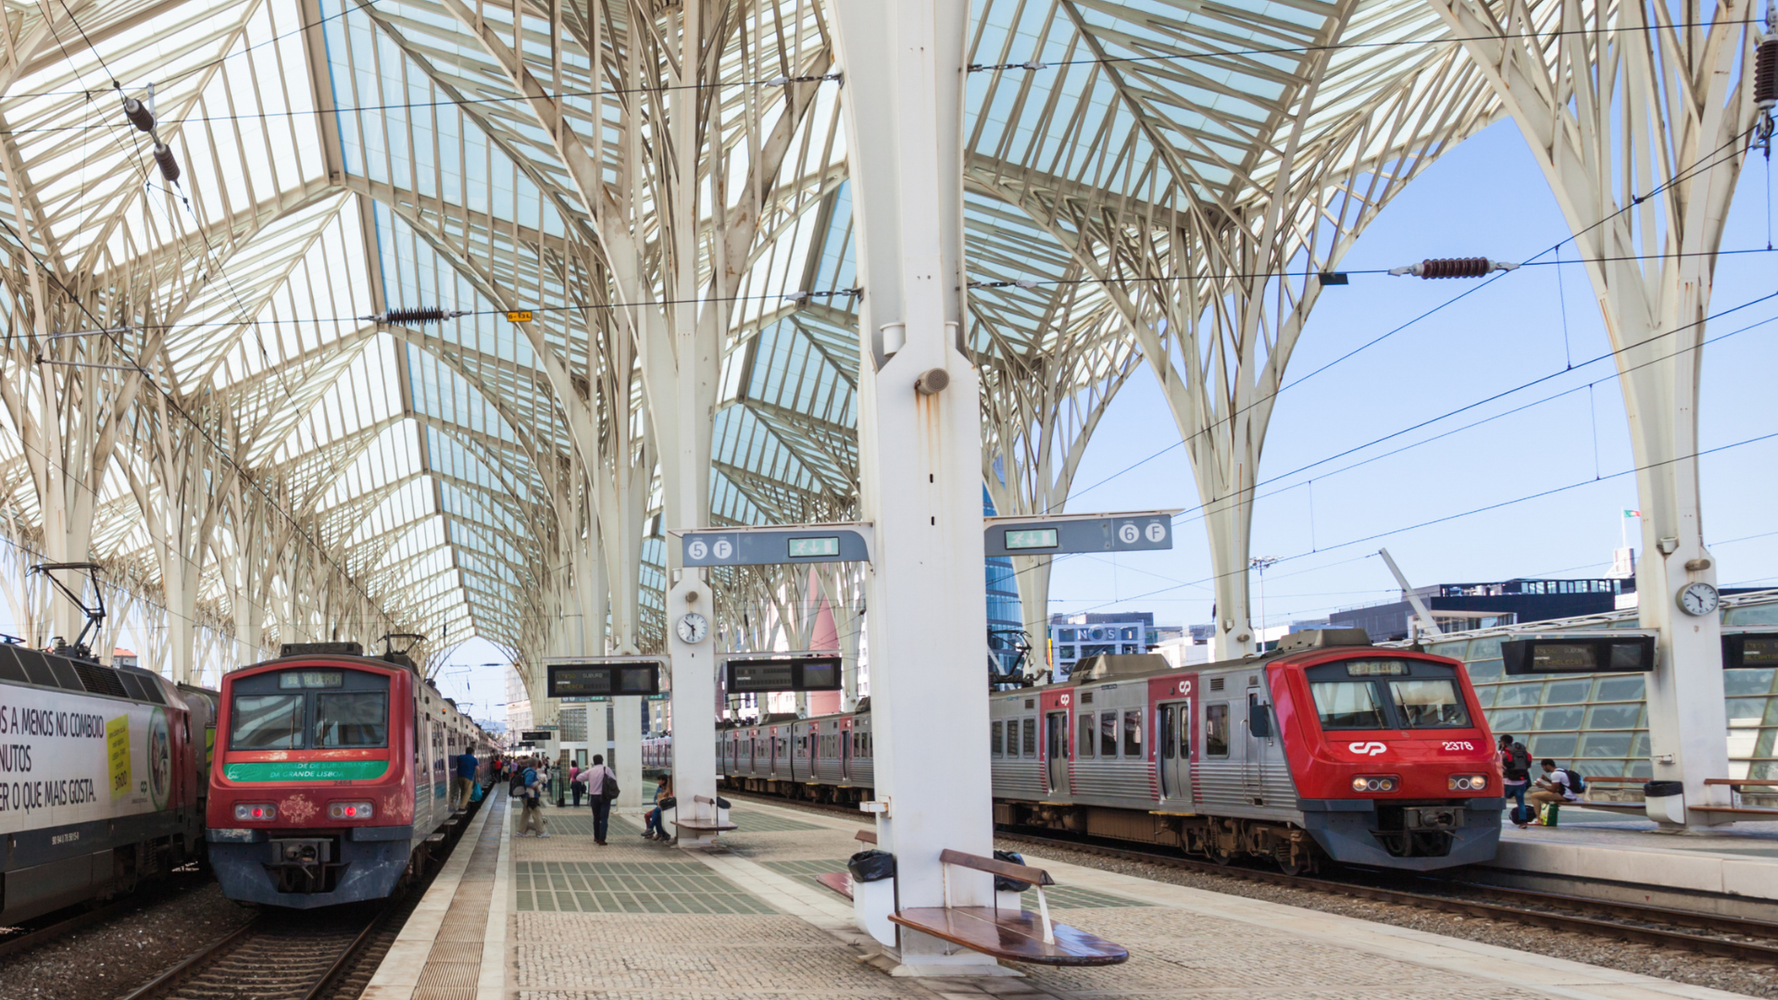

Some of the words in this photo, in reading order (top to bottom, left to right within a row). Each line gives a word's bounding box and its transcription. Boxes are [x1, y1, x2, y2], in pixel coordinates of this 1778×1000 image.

[1124, 526, 1135, 541] 6
[1152, 525, 1160, 540] F
[694, 544, 703, 557] 5
[719, 543, 727, 556] F
[10, 706, 19, 735] A
[22, 707, 54, 736] MENOS
[56, 711, 68, 737] NO
[70, 712, 104, 738] COMBOIO
[1442, 741, 1474, 751] 2378
[12, 782, 20, 811] O
[23, 781, 42, 815] QUE
[45, 780, 67, 807] MAIS
